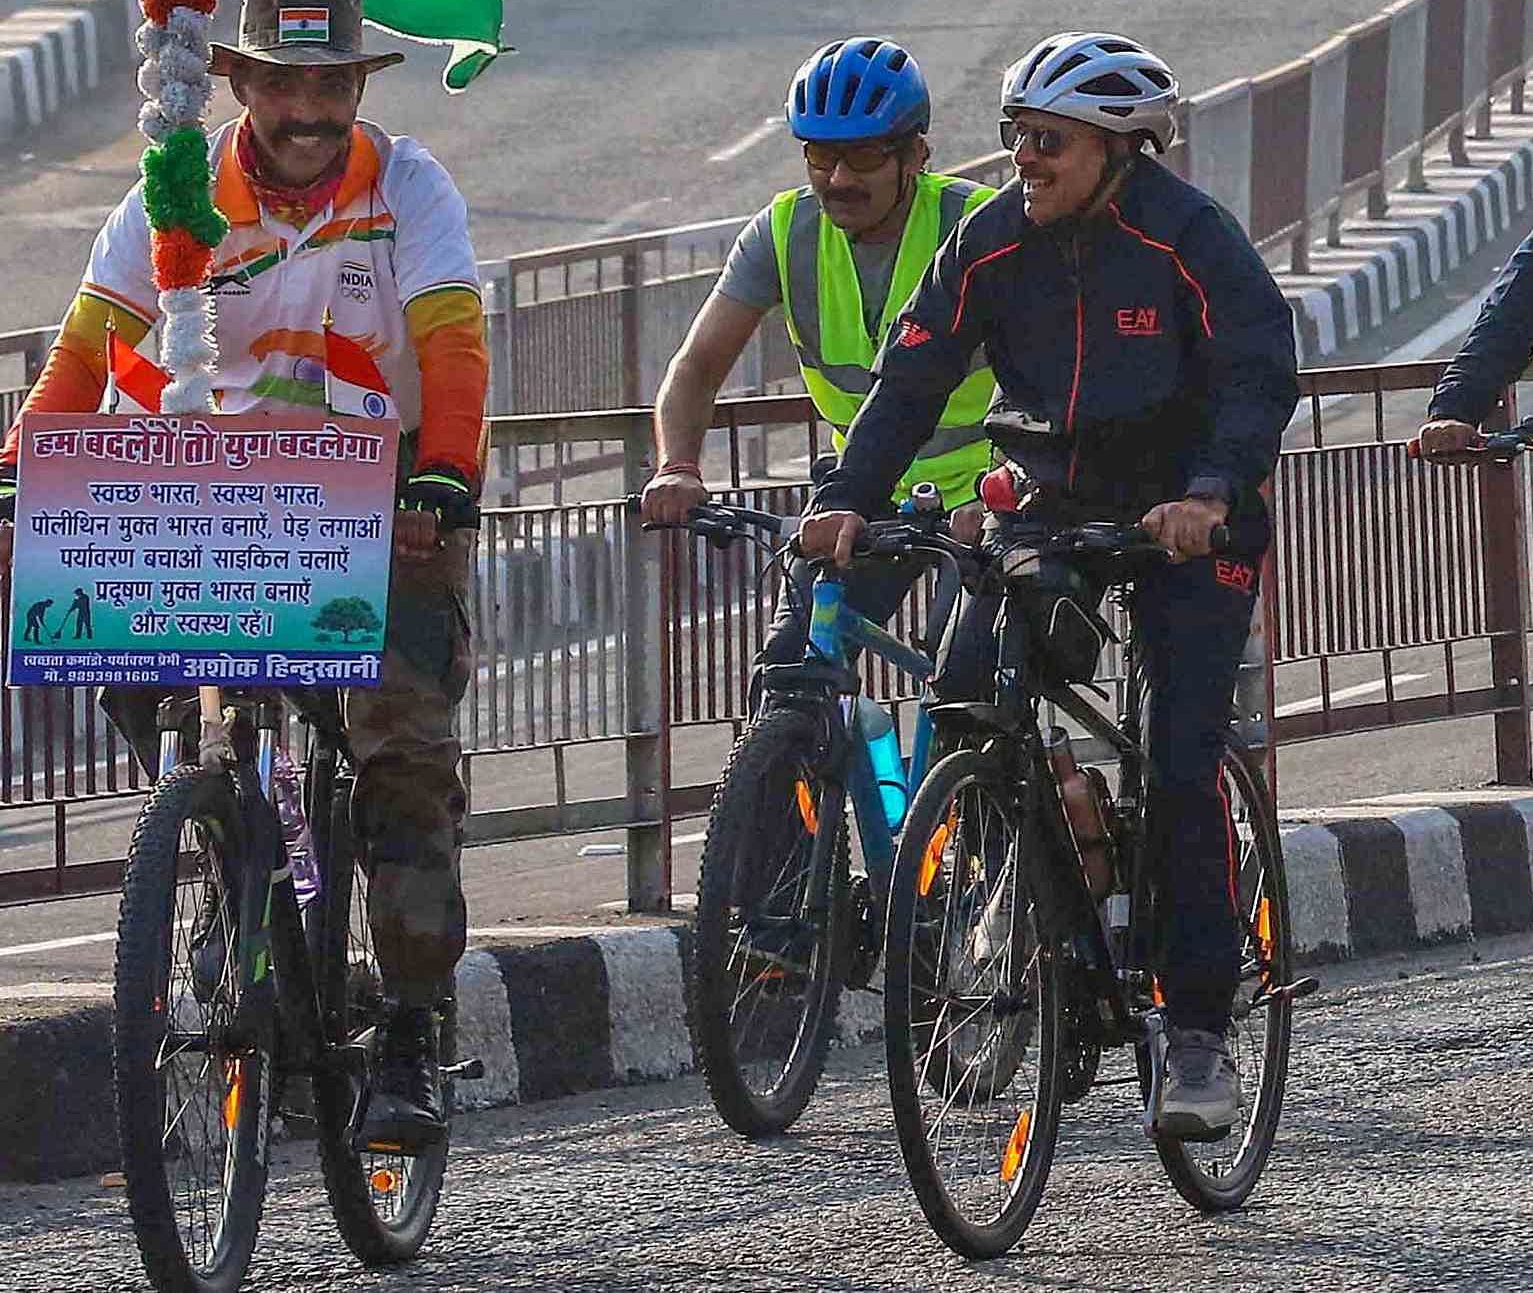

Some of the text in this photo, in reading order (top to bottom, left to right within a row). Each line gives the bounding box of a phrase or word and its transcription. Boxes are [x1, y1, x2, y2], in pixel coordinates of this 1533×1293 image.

[34, 430, 79, 457] हम
[182, 419, 218, 466] तो
[222, 432, 272, 470] युग
[277, 423, 383, 463] बदलेगा
[89, 482, 325, 509] स्वच्छ भारत, स्वस्थ भारत,
[31, 509, 111, 537] पोलीथिन
[117, 515, 160, 542] मुक्त
[166, 515, 213, 538] भारत
[283, 511, 310, 542] पेड़
[60, 542, 135, 569] पर्यावरण
[143, 544, 203, 569] बचाओं
[212, 544, 290, 571] साइकिल
[95, 580, 153, 608] प्रदूषण
[160, 580, 203, 608] मुक्त
[211, 581, 256, 603] भारत
[131, 608, 170, 635] और
[176, 613, 230, 636] स्वस्थ
[183, 652, 382, 686] अशोक हिन्दुस्तानी
